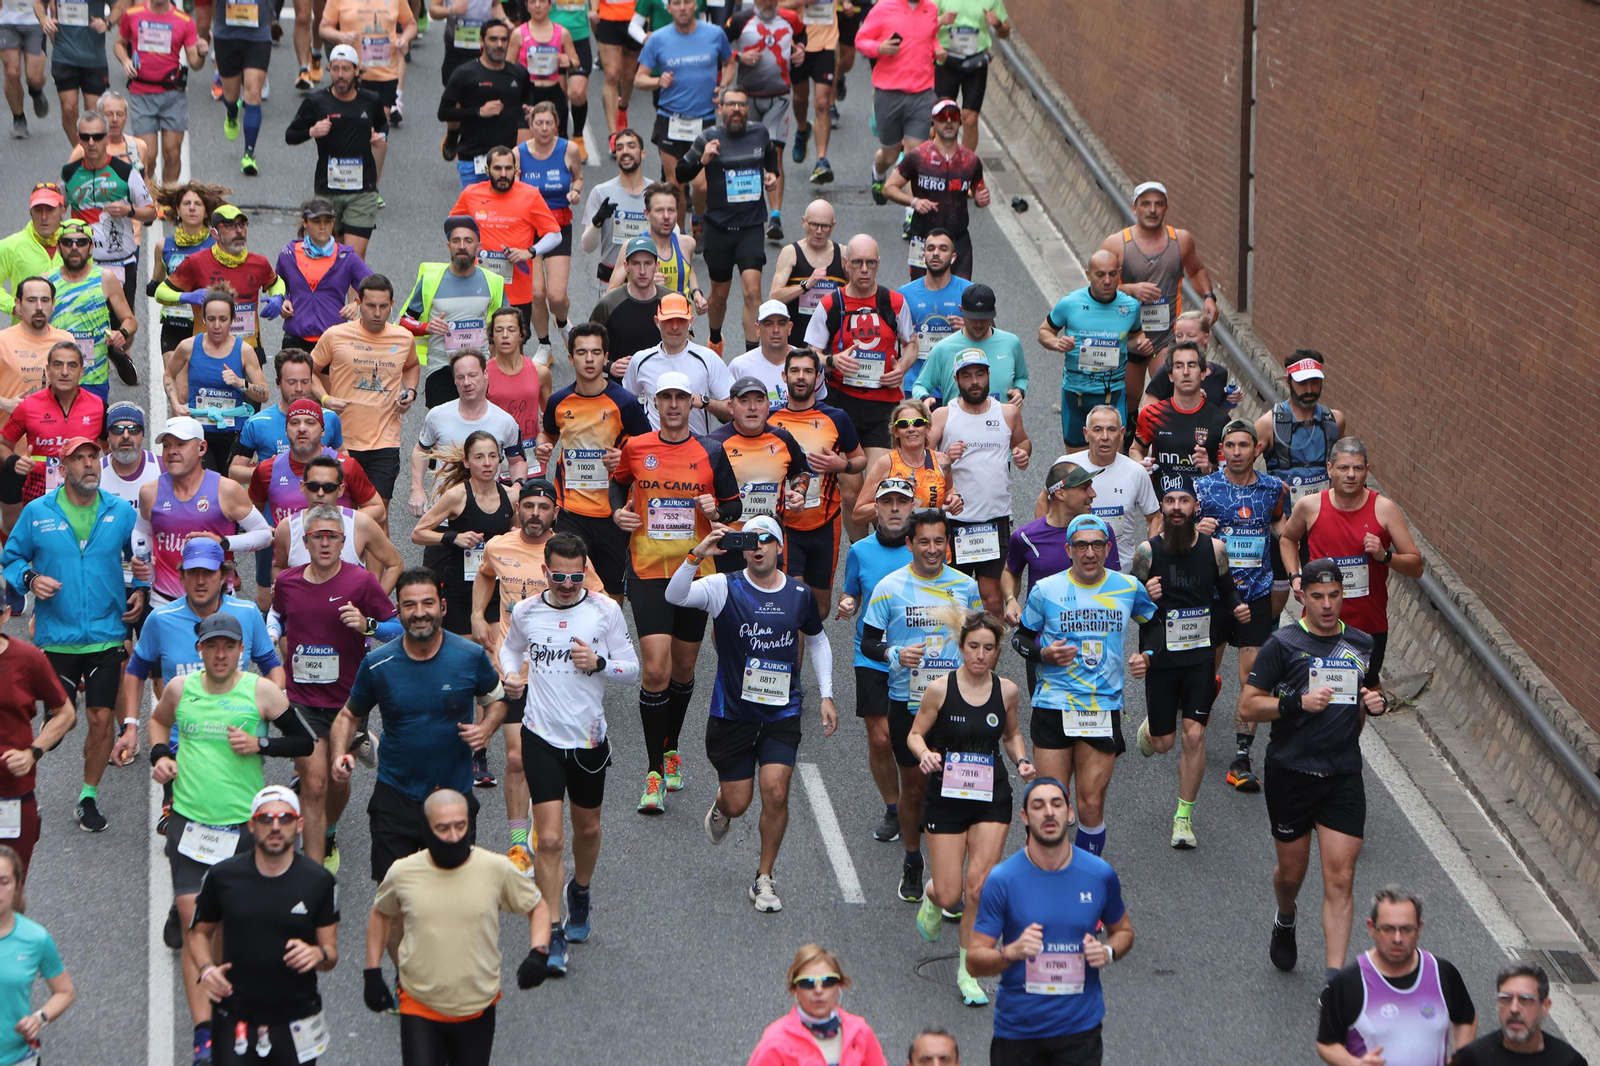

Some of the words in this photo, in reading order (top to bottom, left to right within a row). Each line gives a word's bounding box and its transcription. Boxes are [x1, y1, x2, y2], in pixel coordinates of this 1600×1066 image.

[918, 179, 945, 191] HERO
[858, 351, 881, 359] ZURICH
[208, 390, 233, 398] ZURICH
[36, 436, 54, 446] Los
[966, 441, 1001, 450] outsystems
[1303, 473, 1326, 485] ZURICH
[638, 479, 661, 490] CDA
[663, 480, 706, 493] CAMAS
[753, 484, 775, 492] ZURICH
[663, 499, 690, 507] ZURICH
[750, 496, 767, 505] 10069
[662, 512, 680, 520] 7552
[1094, 507, 1120, 516] ZURICH
[967, 525, 993, 534] ZURICH
[1235, 527, 1261, 535] ZURICH
[968, 538, 985, 546] 9300
[1233, 541, 1253, 549] 11037
[1336, 557, 1363, 566] ZURICH
[501, 575, 522, 583] Maratón
[1176, 576, 1201, 588] RUN
[1059, 609, 1123, 622] DEPORTIVO
[1181, 609, 1207, 617] ZURICH
[739, 622, 774, 638] Palma
[1060, 621, 1123, 633] CHARQUITO
[1181, 623, 1198, 631] 8229
[306, 647, 334, 655] ZURICH
[305, 661, 323, 669] 9624
[762, 661, 788, 671] ZURICH
[1325, 659, 1353, 668] ZURICH
[759, 675, 777, 685] 8817
[1325, 674, 1343, 682] 9488
[747, 685, 763, 694] Rober
[183, 720, 199, 734] Las
[963, 754, 990, 764] ZURICH
[961, 769, 979, 778] 7816
[963, 781, 975, 789] ANE
[1047, 942, 1080, 952] ZURICH
